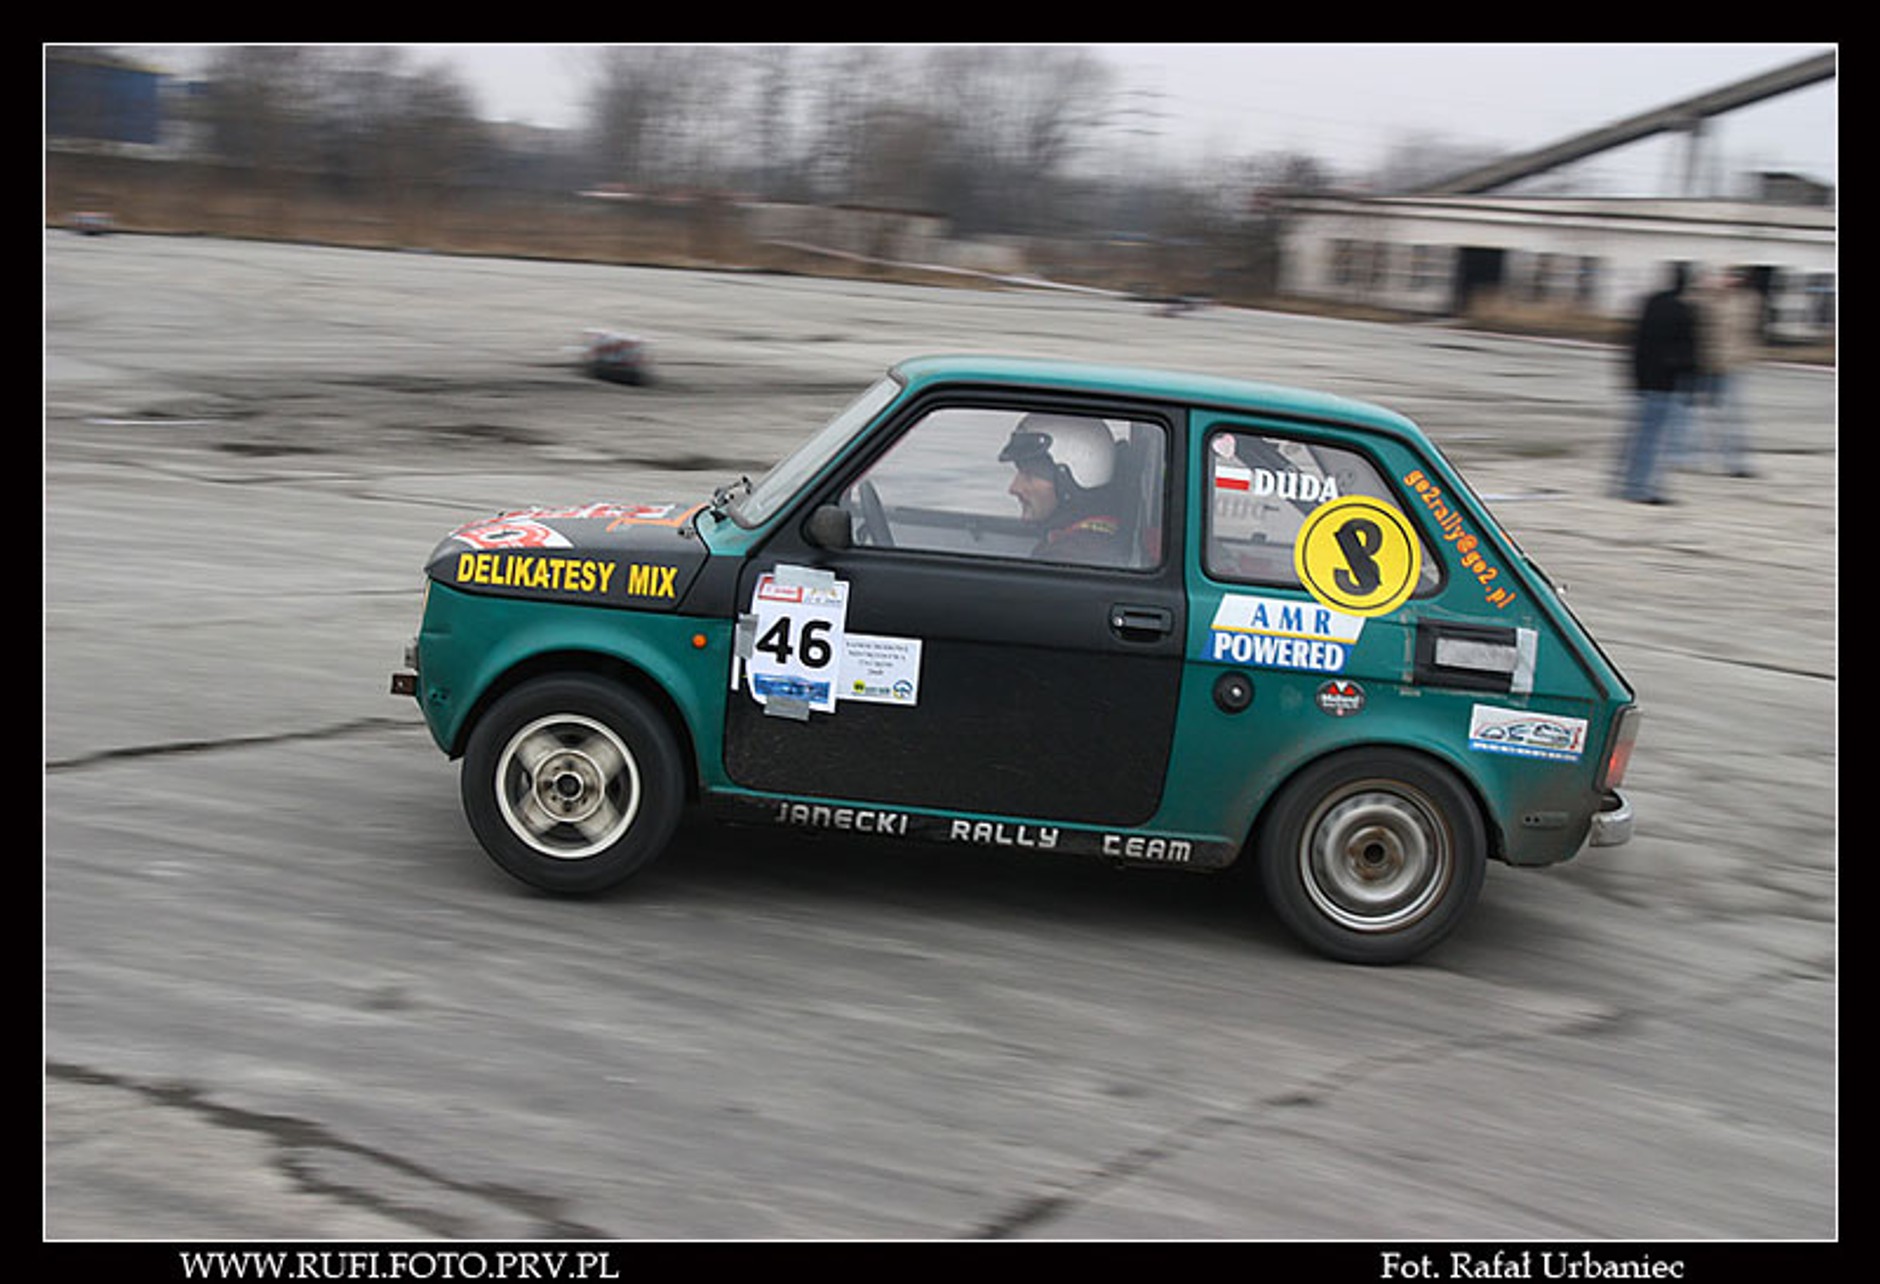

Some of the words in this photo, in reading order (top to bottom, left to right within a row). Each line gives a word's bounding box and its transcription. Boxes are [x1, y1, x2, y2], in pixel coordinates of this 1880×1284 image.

[1254, 467, 1340, 503] DUDA
[456, 552, 616, 593] DELIKATESY
[627, 564, 679, 598] MIX
[755, 616, 833, 670] 46
[1213, 632, 1345, 672] POWERED
[775, 802, 909, 835] JANECKI
[950, 818, 1060, 849] RALLY
